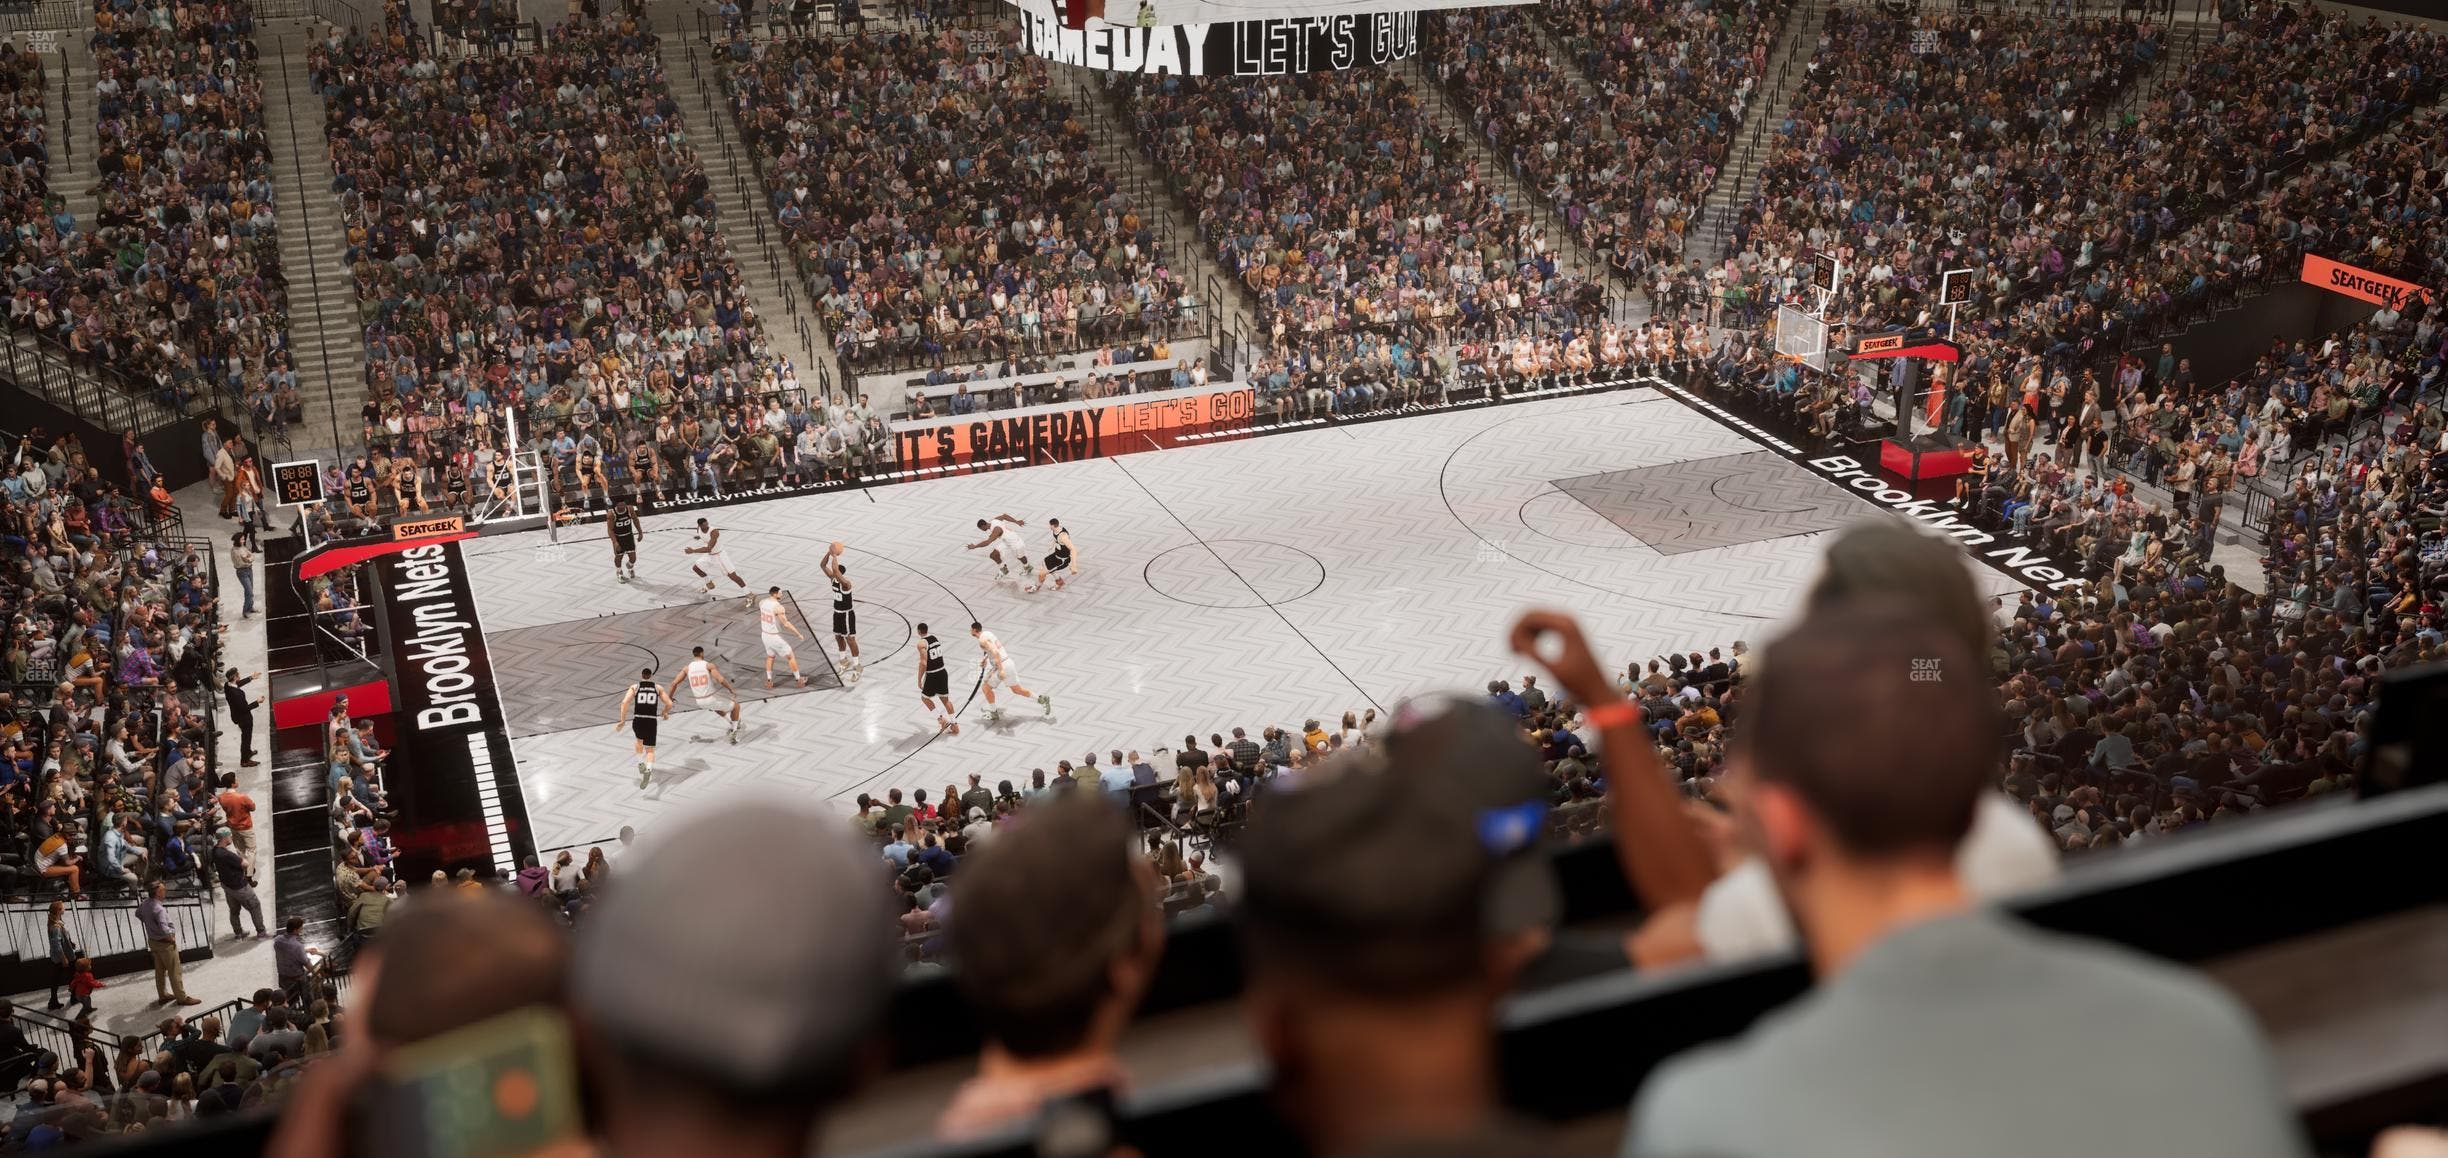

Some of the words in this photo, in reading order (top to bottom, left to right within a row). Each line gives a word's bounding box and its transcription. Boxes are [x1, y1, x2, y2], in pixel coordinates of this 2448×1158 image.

[1031, 12, 1211, 75] GAMEDAY
[1234, 15, 1355, 75] LET'S
[1371, 11, 1418, 64] GO!
[2330, 268, 2403, 304] SEATGEEK
[1864, 338, 1898, 350] SEATGEEK
[896, 426, 955, 461] IT'S
[969, 408, 1105, 452] GAMEDAY
[1117, 397, 1197, 433] LET'S
[1210, 389, 1256, 422] GO!
[400, 519, 458, 537] SEATGEEK
[394, 543, 453, 601] Nets
[1984, 545, 2090, 596] Net
[404, 602, 482, 730] Brooklyn
[637, 692, 656, 704] 00
